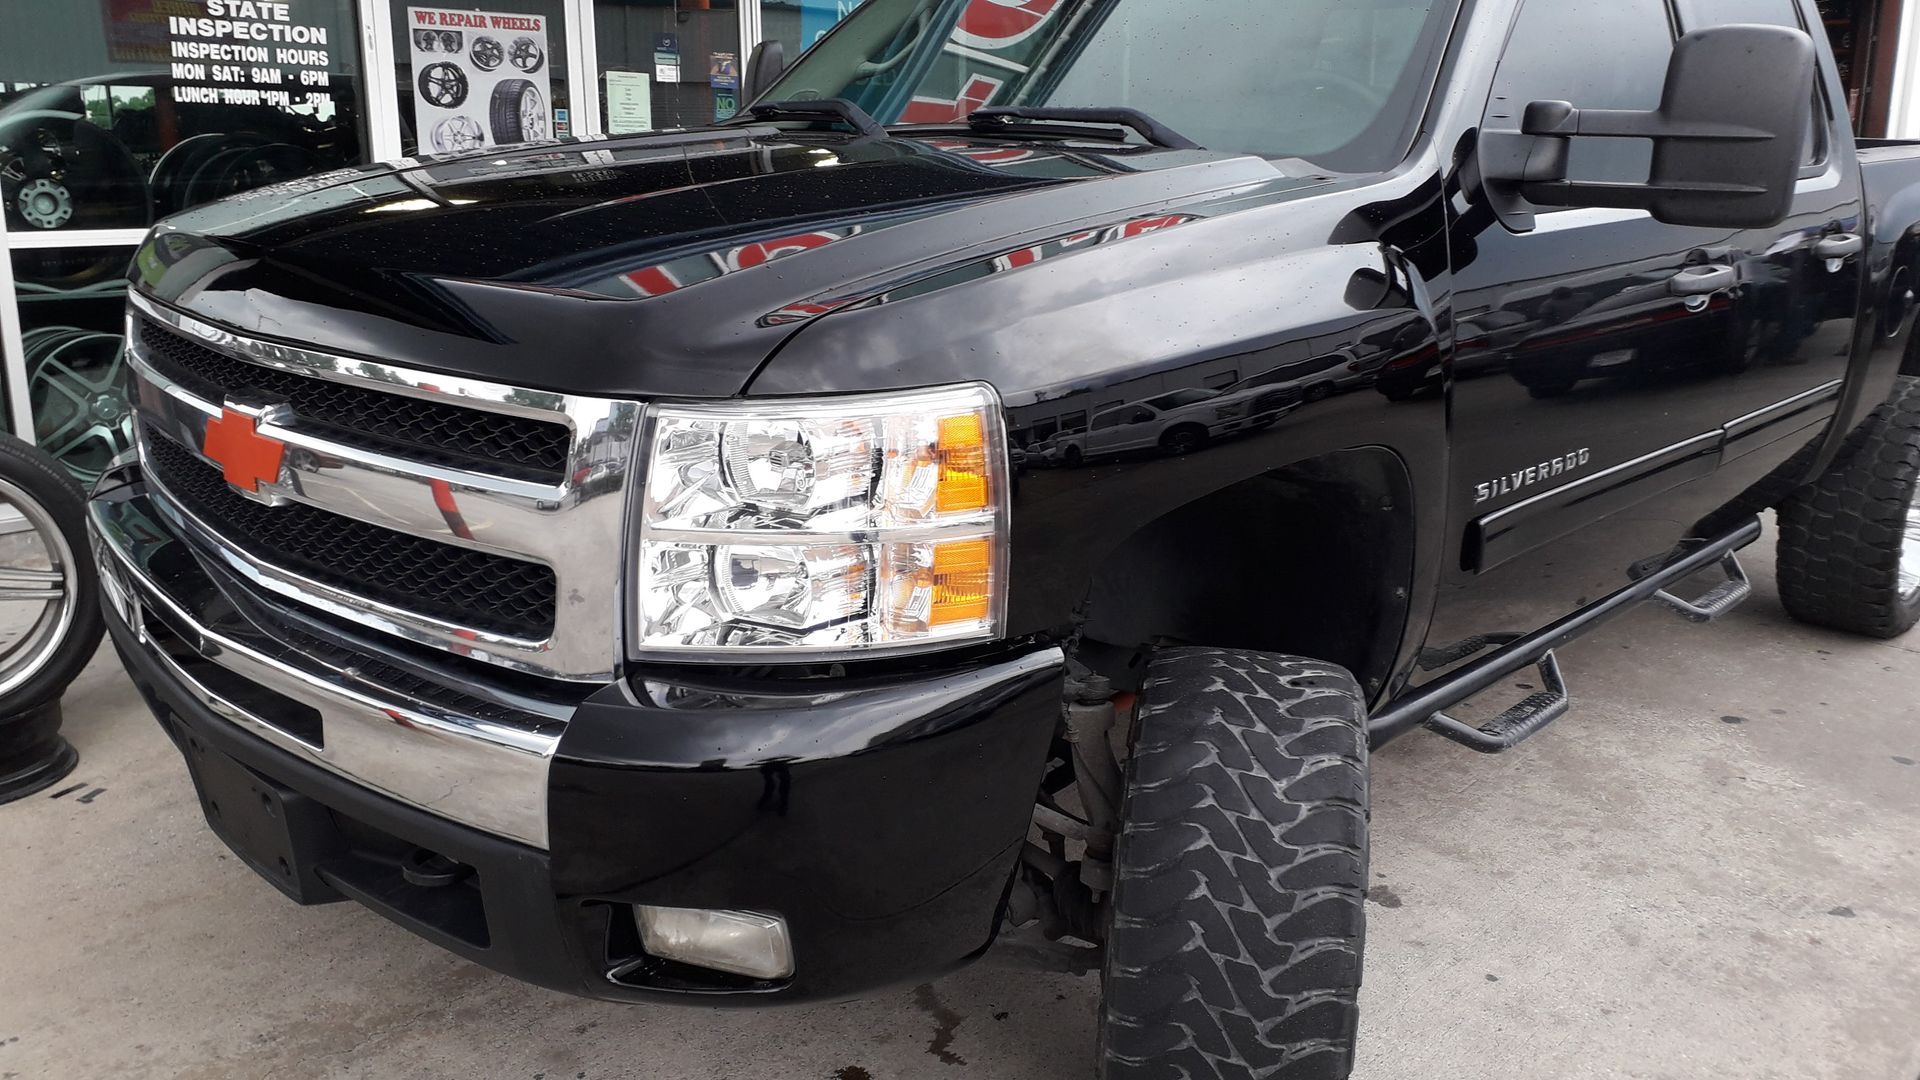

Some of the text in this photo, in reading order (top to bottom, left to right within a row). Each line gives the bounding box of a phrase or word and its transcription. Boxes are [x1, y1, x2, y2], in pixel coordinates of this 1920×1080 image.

[207, 0, 290, 21] STATE
[414, 11, 541, 32] WE REPAIR WHEELS
[169, 16, 327, 45] INSPECTION
[171, 41, 269, 63] INSPECTION
[276, 48, 329, 66] HOURS
[171, 63, 206, 80] MON
[211, 65, 245, 82] SAT:
[251, 68, 282, 84] 9AM
[300, 70, 329, 86] 6PM
[174, 86, 218, 103] LUNCH
[223, 89, 260, 105] HOUR
[305, 92, 330, 107] 2PM
[716, 97, 735, 109] NO
[1474, 447, 1589, 504] SILVERADO
